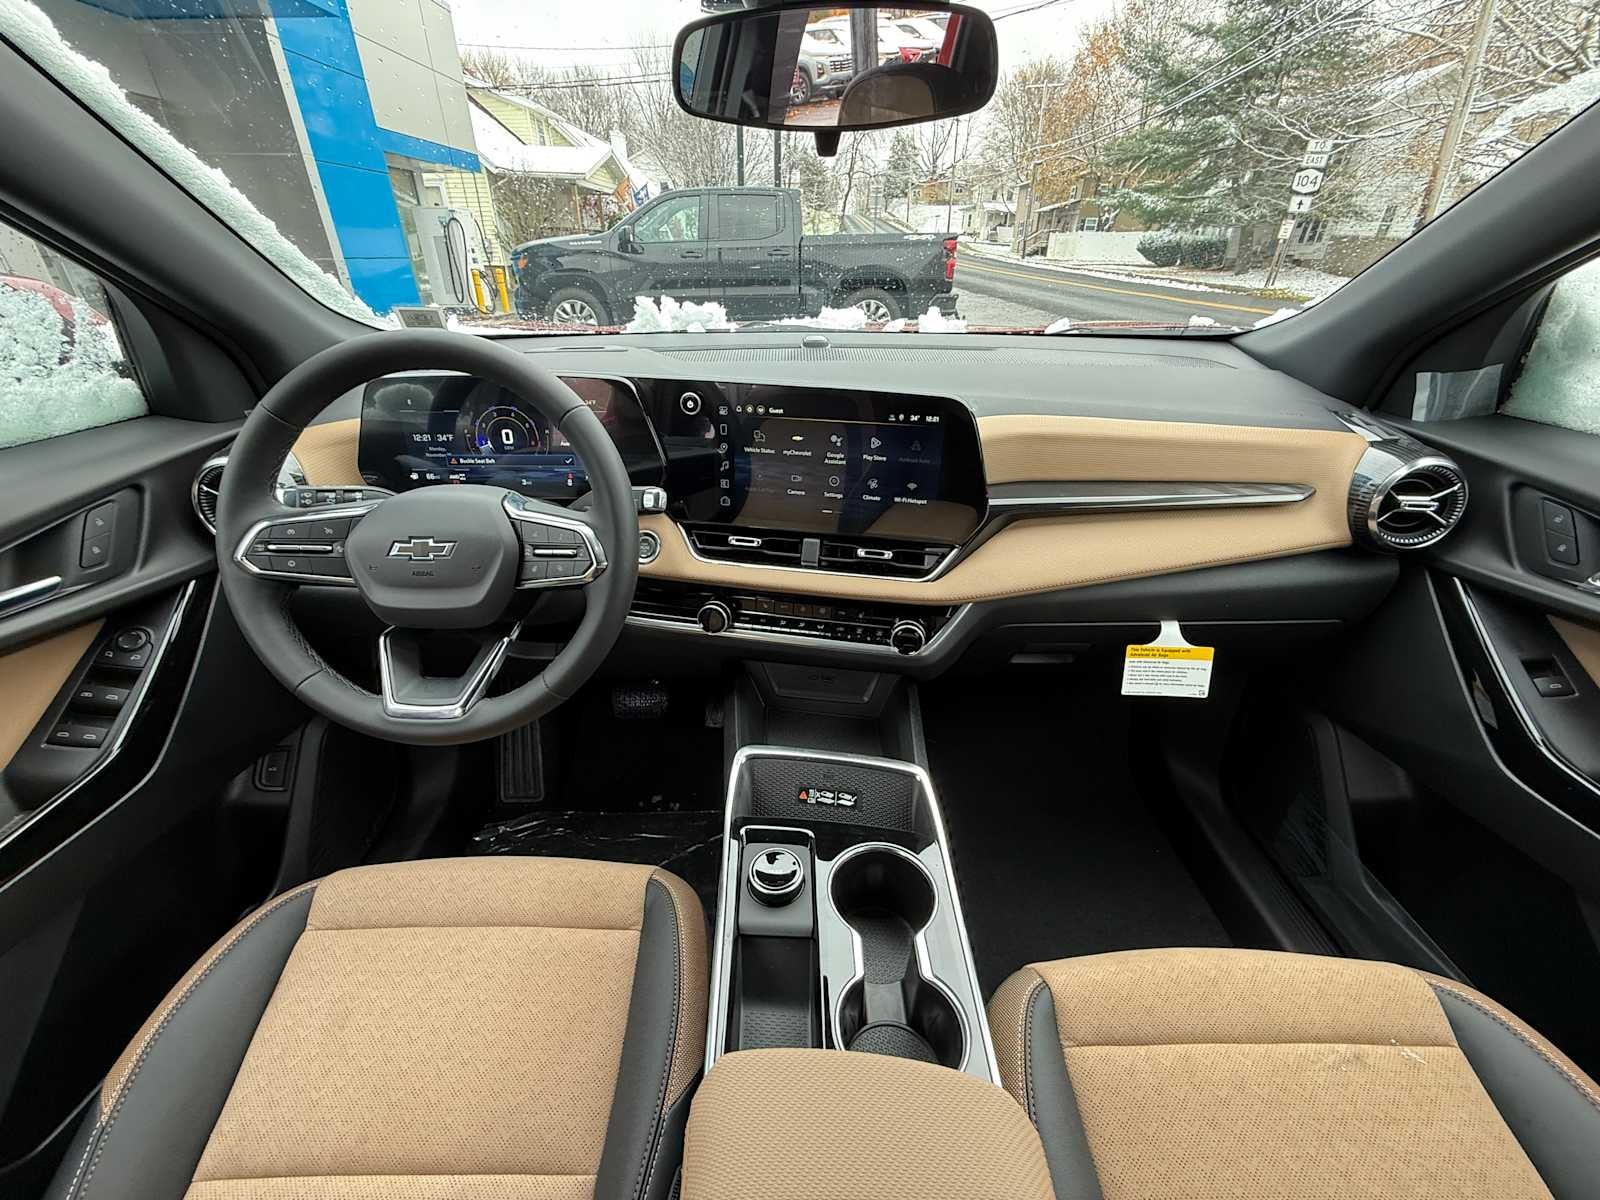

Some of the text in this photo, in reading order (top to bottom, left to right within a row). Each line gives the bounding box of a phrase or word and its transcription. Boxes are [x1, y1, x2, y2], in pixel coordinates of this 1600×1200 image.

[1314, 141, 1326, 150] TO
[1305, 156, 1325, 164] EAST
[1296, 175, 1319, 188] 104
[437, 434, 454, 442] 34°F
[501, 428, 514, 444] 0
[783, 449, 812, 457] myChevrolet
[824, 491, 844, 499] Settings
